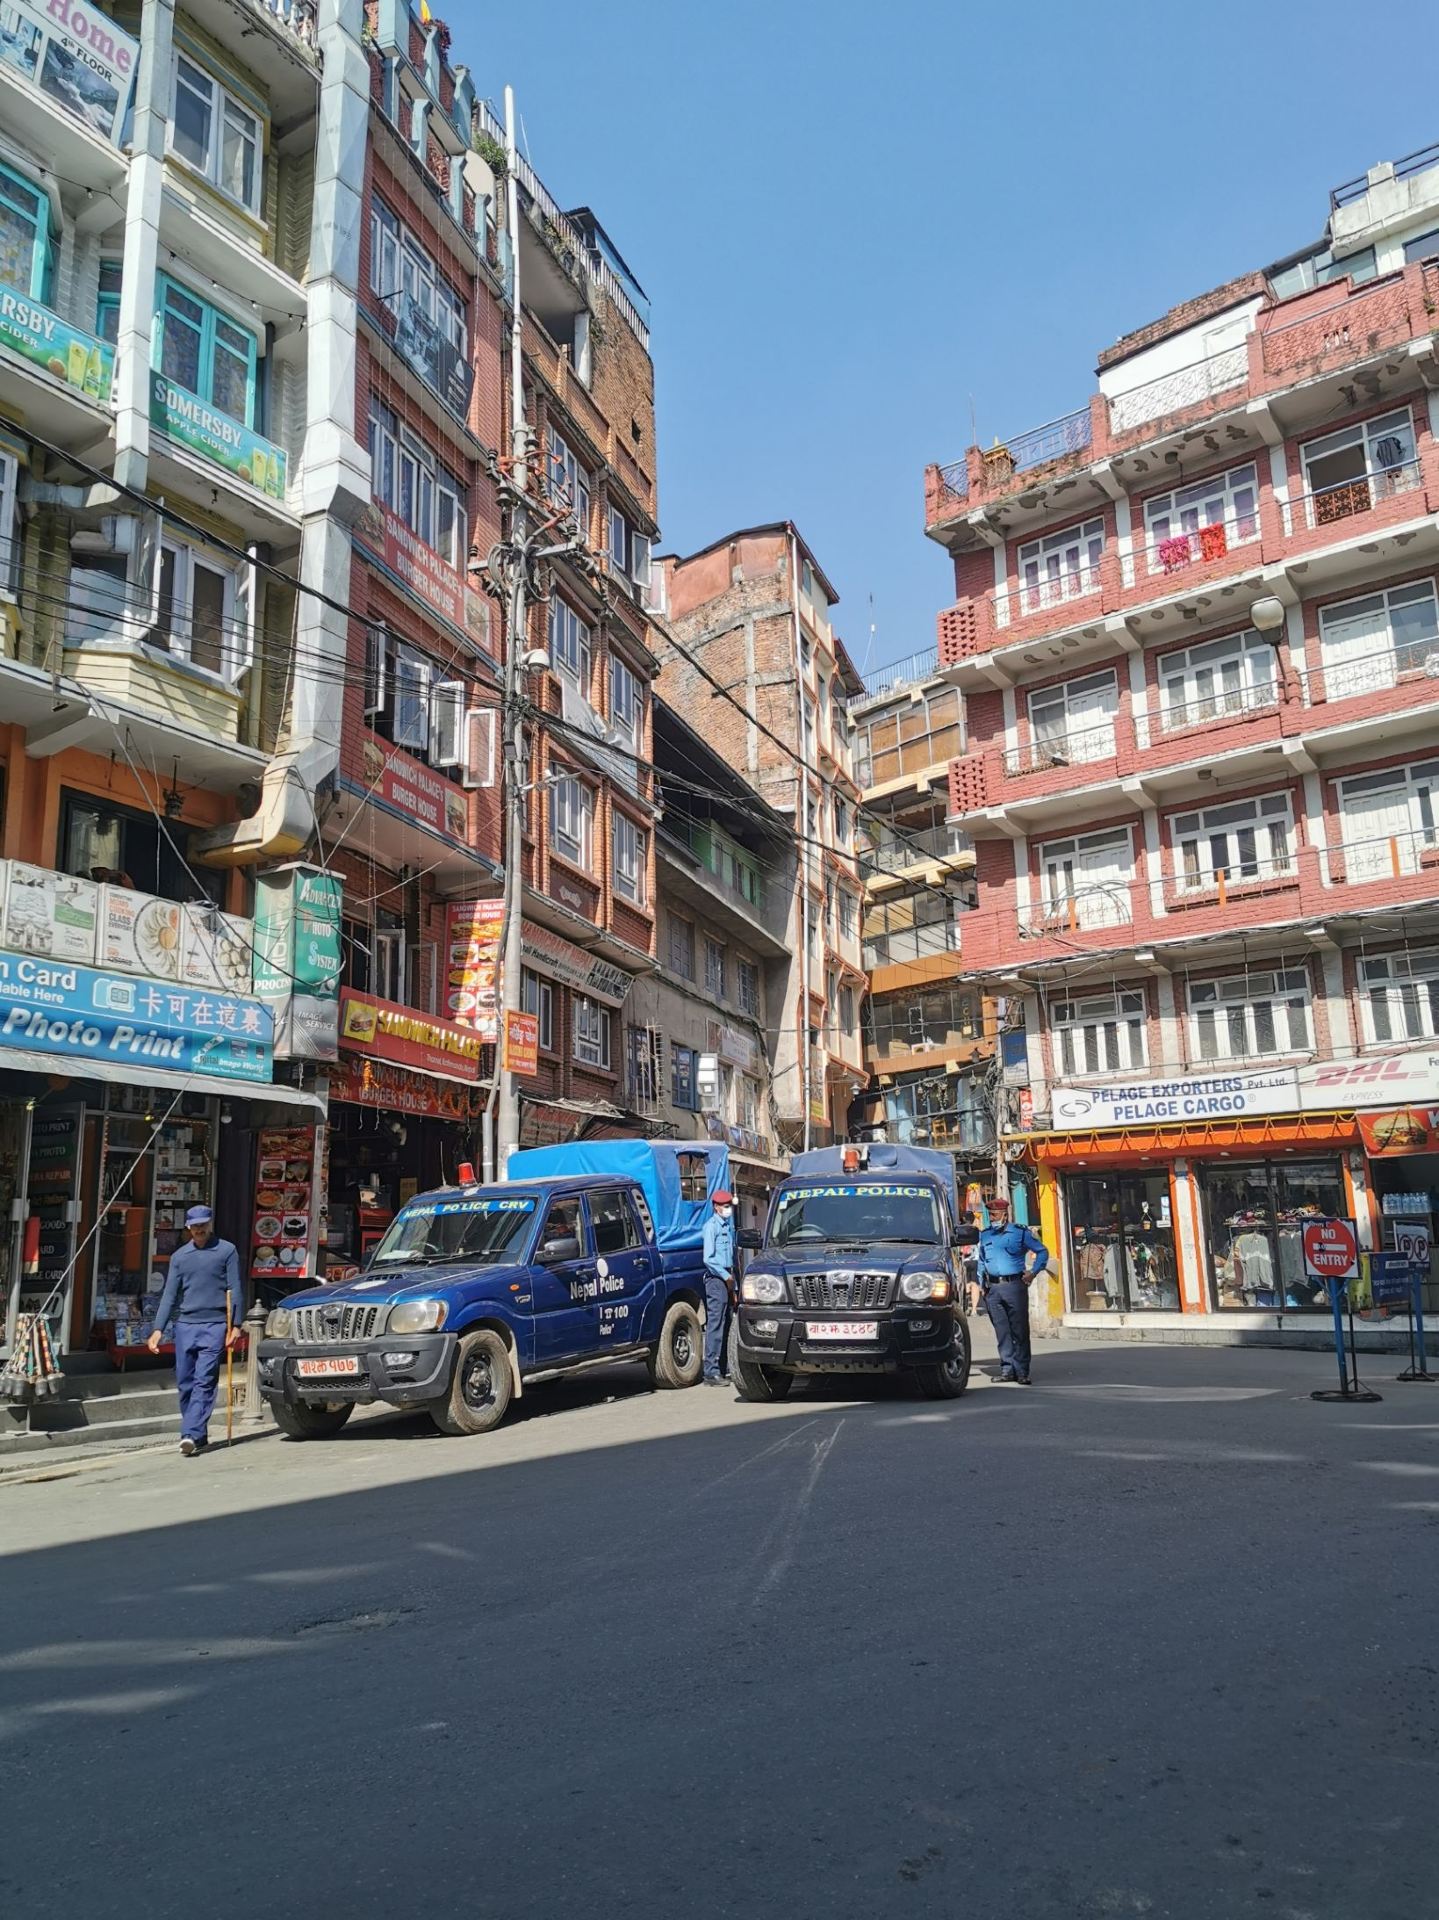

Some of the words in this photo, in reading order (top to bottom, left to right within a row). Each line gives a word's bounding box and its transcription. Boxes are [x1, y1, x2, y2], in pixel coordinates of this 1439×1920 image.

[76, 48, 112, 82] FLOOR
[0, 321, 38, 349] CIDER
[166, 414, 198, 437] APPLE
[200, 434, 230, 457] CIDER
[387, 514, 429, 568] SANDWICH
[397, 550, 429, 594] BURGER
[430, 580, 455, 616] HOUSE
[385, 752, 417, 785] SANDWICH
[392, 782, 417, 812] BURGER
[417, 797, 437, 823] HOUSE
[109, 913, 131, 925] CLASS
[308, 940, 338, 970] SYSTEM
[531, 949, 559, 968] Handicraft
[18, 960, 76, 991] Card
[34, 987, 65, 1003] Here
[2, 1007, 101, 1047] Photo
[109, 1026, 184, 1059] Print
[305, 1020, 335, 1031] SERVICE
[377, 1010, 440, 1046] SANDWICH
[440, 1029, 480, 1060] PALACE
[243, 1061, 264, 1073] World
[1315, 1061, 1410, 1087] DHL
[399, 1093, 428, 1110] HOUSE
[1091, 1086, 1149, 1103] PELAGE
[1152, 1077, 1243, 1098] EXPORTERS
[1248, 1080, 1267, 1089] Pvt.
[1269, 1077, 1288, 1087] Ltd.
[1343, 1091, 1386, 1102] EXPRESS
[1114, 1101, 1179, 1120] PELAGE
[1183, 1095, 1246, 1115] CARGO
[785, 1187, 849, 1200] NEPAL
[854, 1186, 931, 1198] POLICE
[403, 1205, 437, 1219] NEPAL
[498, 1201, 529, 1210] CRV
[1320, 1229, 1336, 1240] NO
[1313, 1254, 1348, 1267] ENTRY
[570, 1279, 598, 1302] Nepal
[600, 1275, 625, 1294] Police
[614, 1305, 629, 1319] 100
